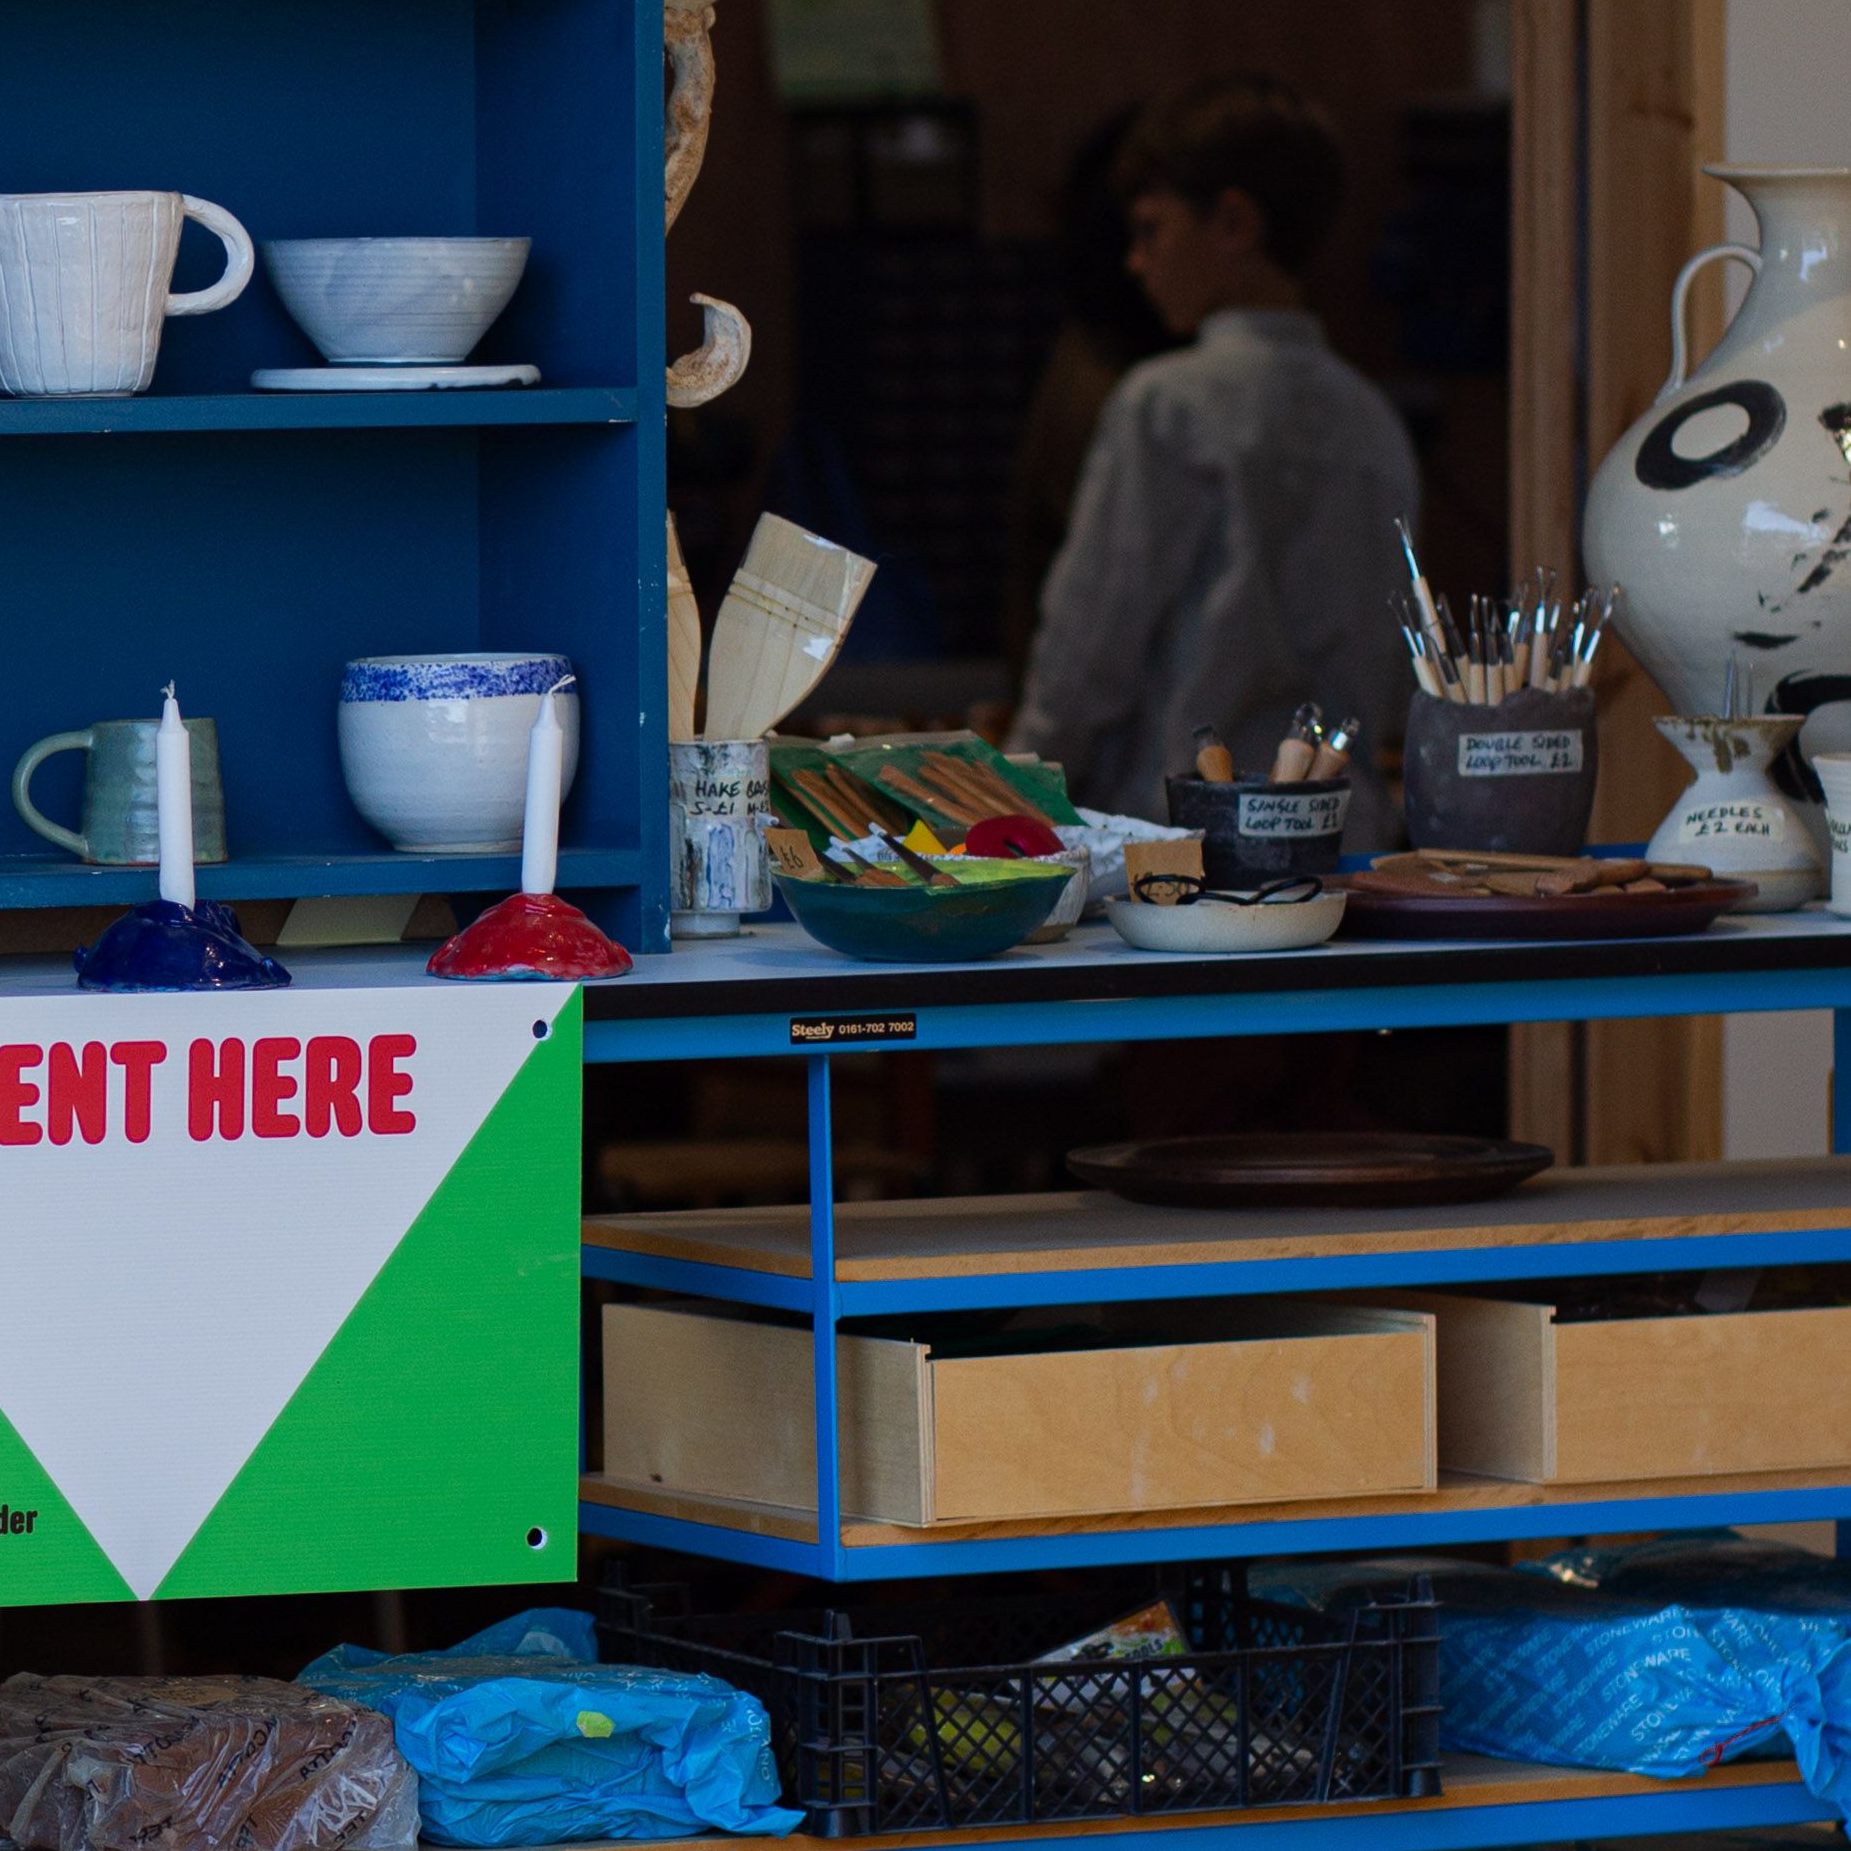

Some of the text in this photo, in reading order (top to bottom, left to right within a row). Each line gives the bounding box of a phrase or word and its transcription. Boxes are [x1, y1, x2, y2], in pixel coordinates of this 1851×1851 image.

[696, 780, 740, 797] HAKE
[1247, 798, 1300, 813] SINGLE
[1686, 806, 1762, 825] NEEDLES
[792, 1022, 835, 1039] Steely
[889, 1022, 914, 1032] 7002
[188, 1034, 416, 1141] HERE
